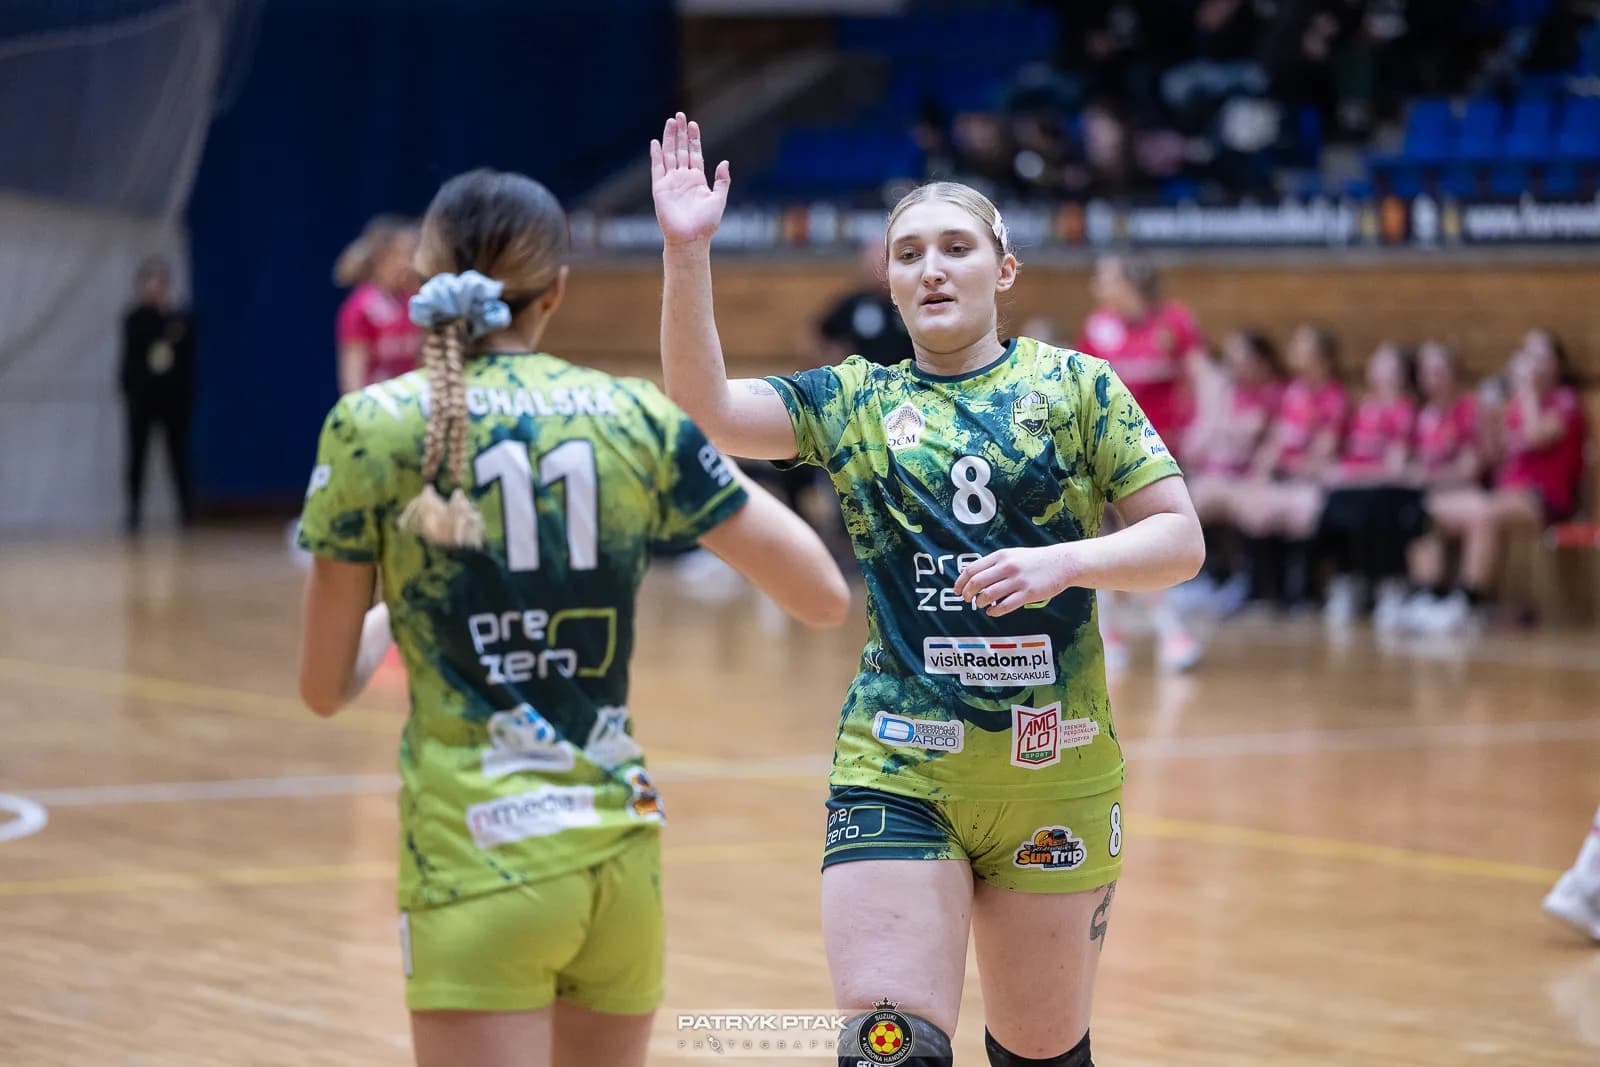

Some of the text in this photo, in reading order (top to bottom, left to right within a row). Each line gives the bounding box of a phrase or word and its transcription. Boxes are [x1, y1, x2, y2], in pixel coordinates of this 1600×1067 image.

[418, 386, 619, 417] CHALSKA
[474, 439, 598, 571] 11
[950, 455, 997, 525] 8
[913, 552, 984, 583] pre
[915, 588, 997, 611] zer
[468, 608, 549, 655] pre
[930, 650, 1048, 669] visitRadom.pl
[966, 671, 1051, 681] RADOM ZASKAKUJE
[828, 808, 848, 831] pre
[1109, 802, 1122, 857] 8
[826, 825, 860, 847] zero
